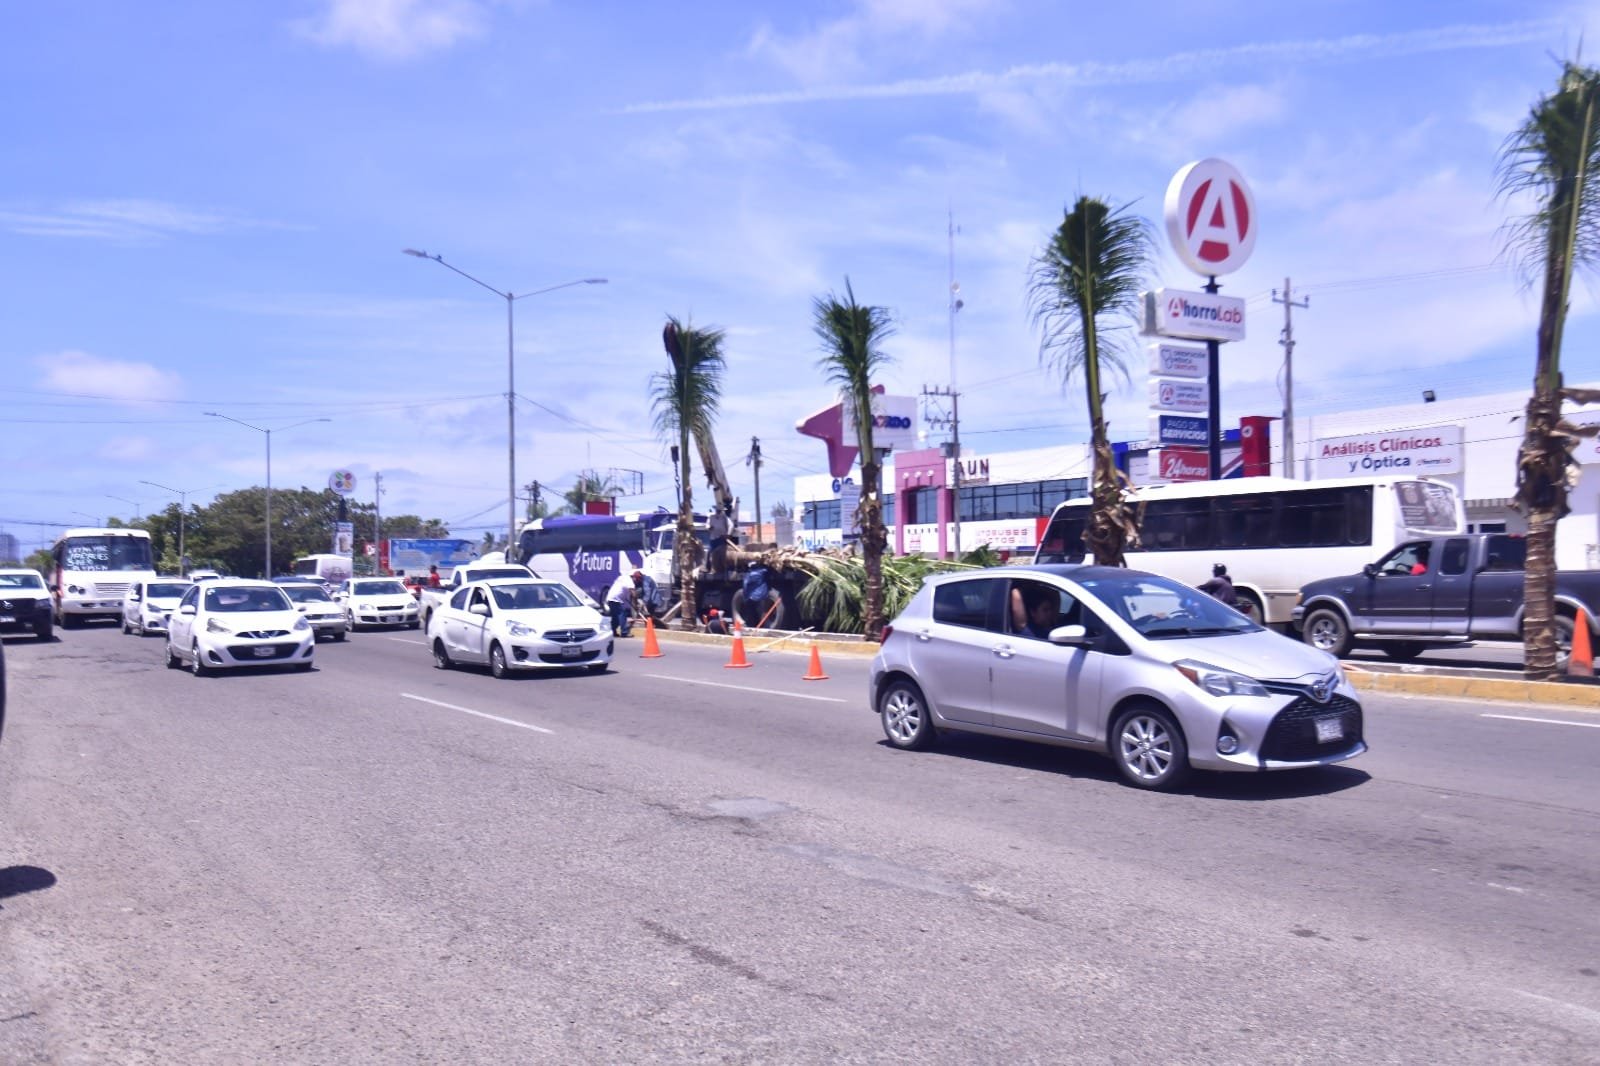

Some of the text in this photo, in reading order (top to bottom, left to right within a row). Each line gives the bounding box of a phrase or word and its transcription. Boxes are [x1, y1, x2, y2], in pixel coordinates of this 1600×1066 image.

[1168, 297, 1243, 325] AhorroLab
[1161, 428, 1208, 441] SERVICIOS
[1322, 436, 1442, 457] Análisis Clínicos
[1348, 460, 1358, 473] y
[1361, 454, 1412, 471] Óptica
[581, 552, 613, 571] Futura
